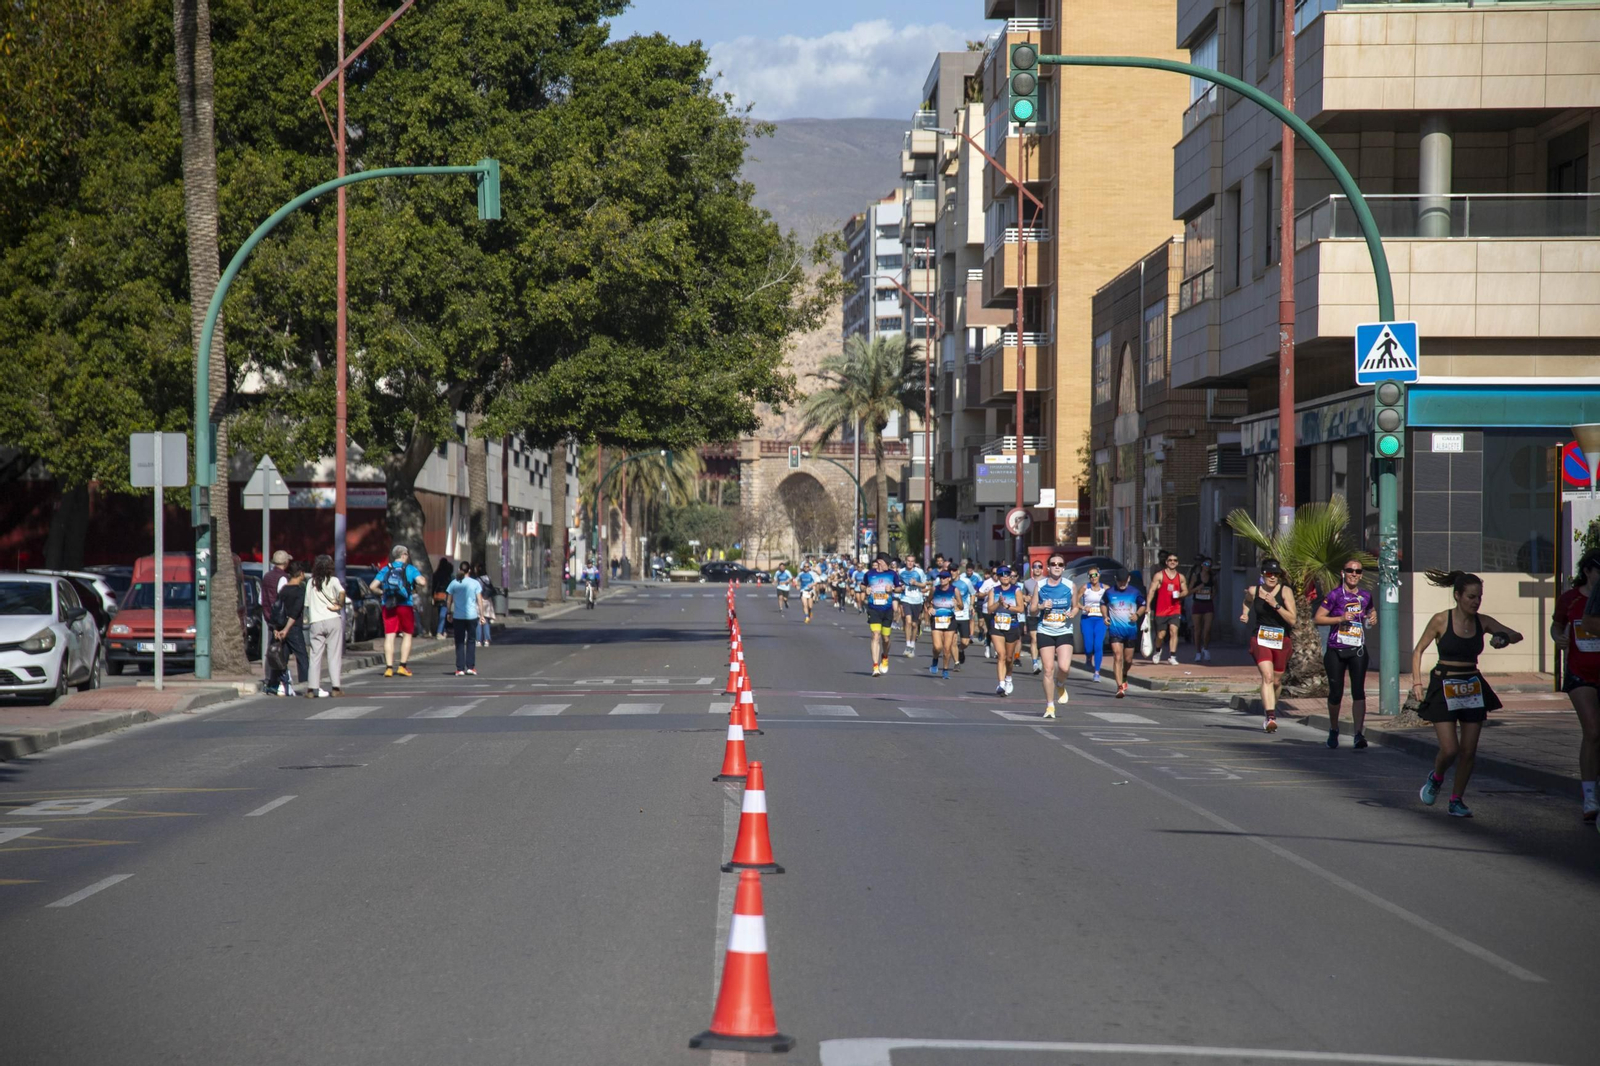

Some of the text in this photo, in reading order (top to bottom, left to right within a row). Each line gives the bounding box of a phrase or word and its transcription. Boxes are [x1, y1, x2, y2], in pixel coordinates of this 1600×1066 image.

[1436, 442, 1460, 450] ALBACETE
[1263, 630, 1279, 640] 655
[1452, 683, 1475, 695] 165
